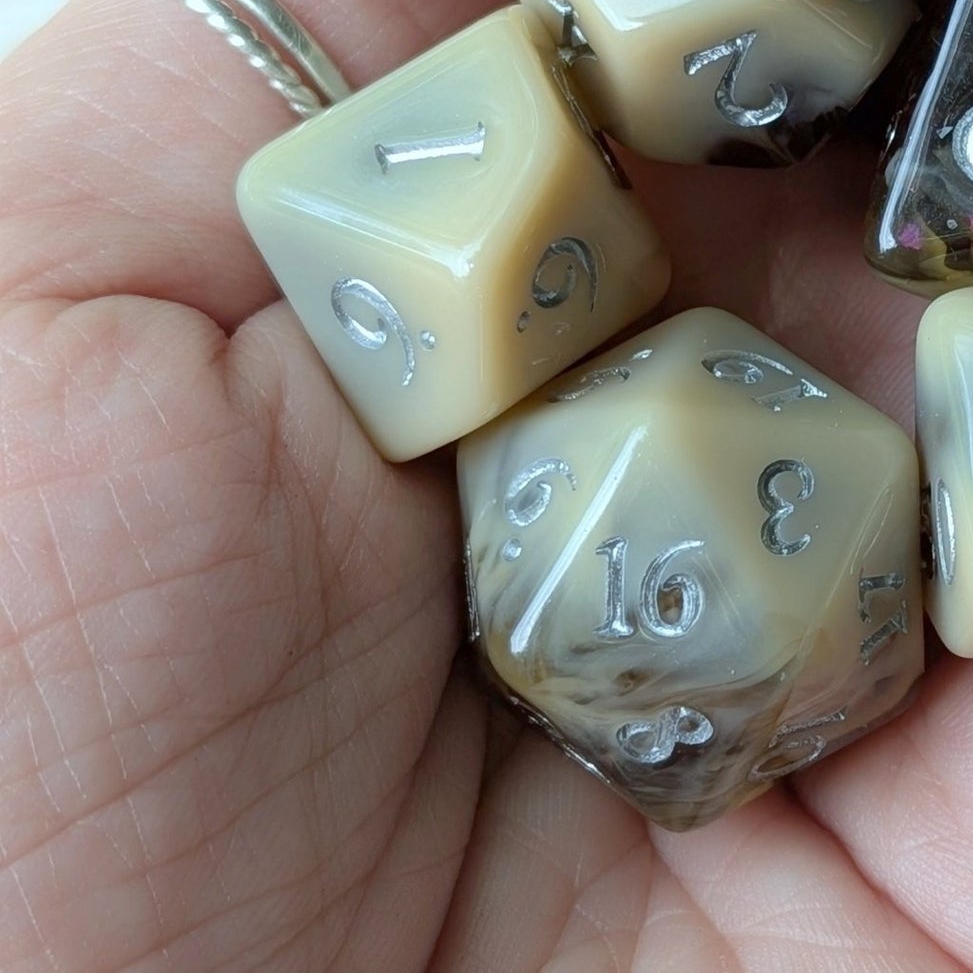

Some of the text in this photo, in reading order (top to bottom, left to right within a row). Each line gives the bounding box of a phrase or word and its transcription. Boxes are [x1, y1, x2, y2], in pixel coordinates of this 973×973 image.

[683, 31, 788, 127] 2
[375, 121, 486, 175] 1
[757, 458, 816, 557] 3
[595, 536, 705, 642] 16
[616, 705, 714, 766] 8
